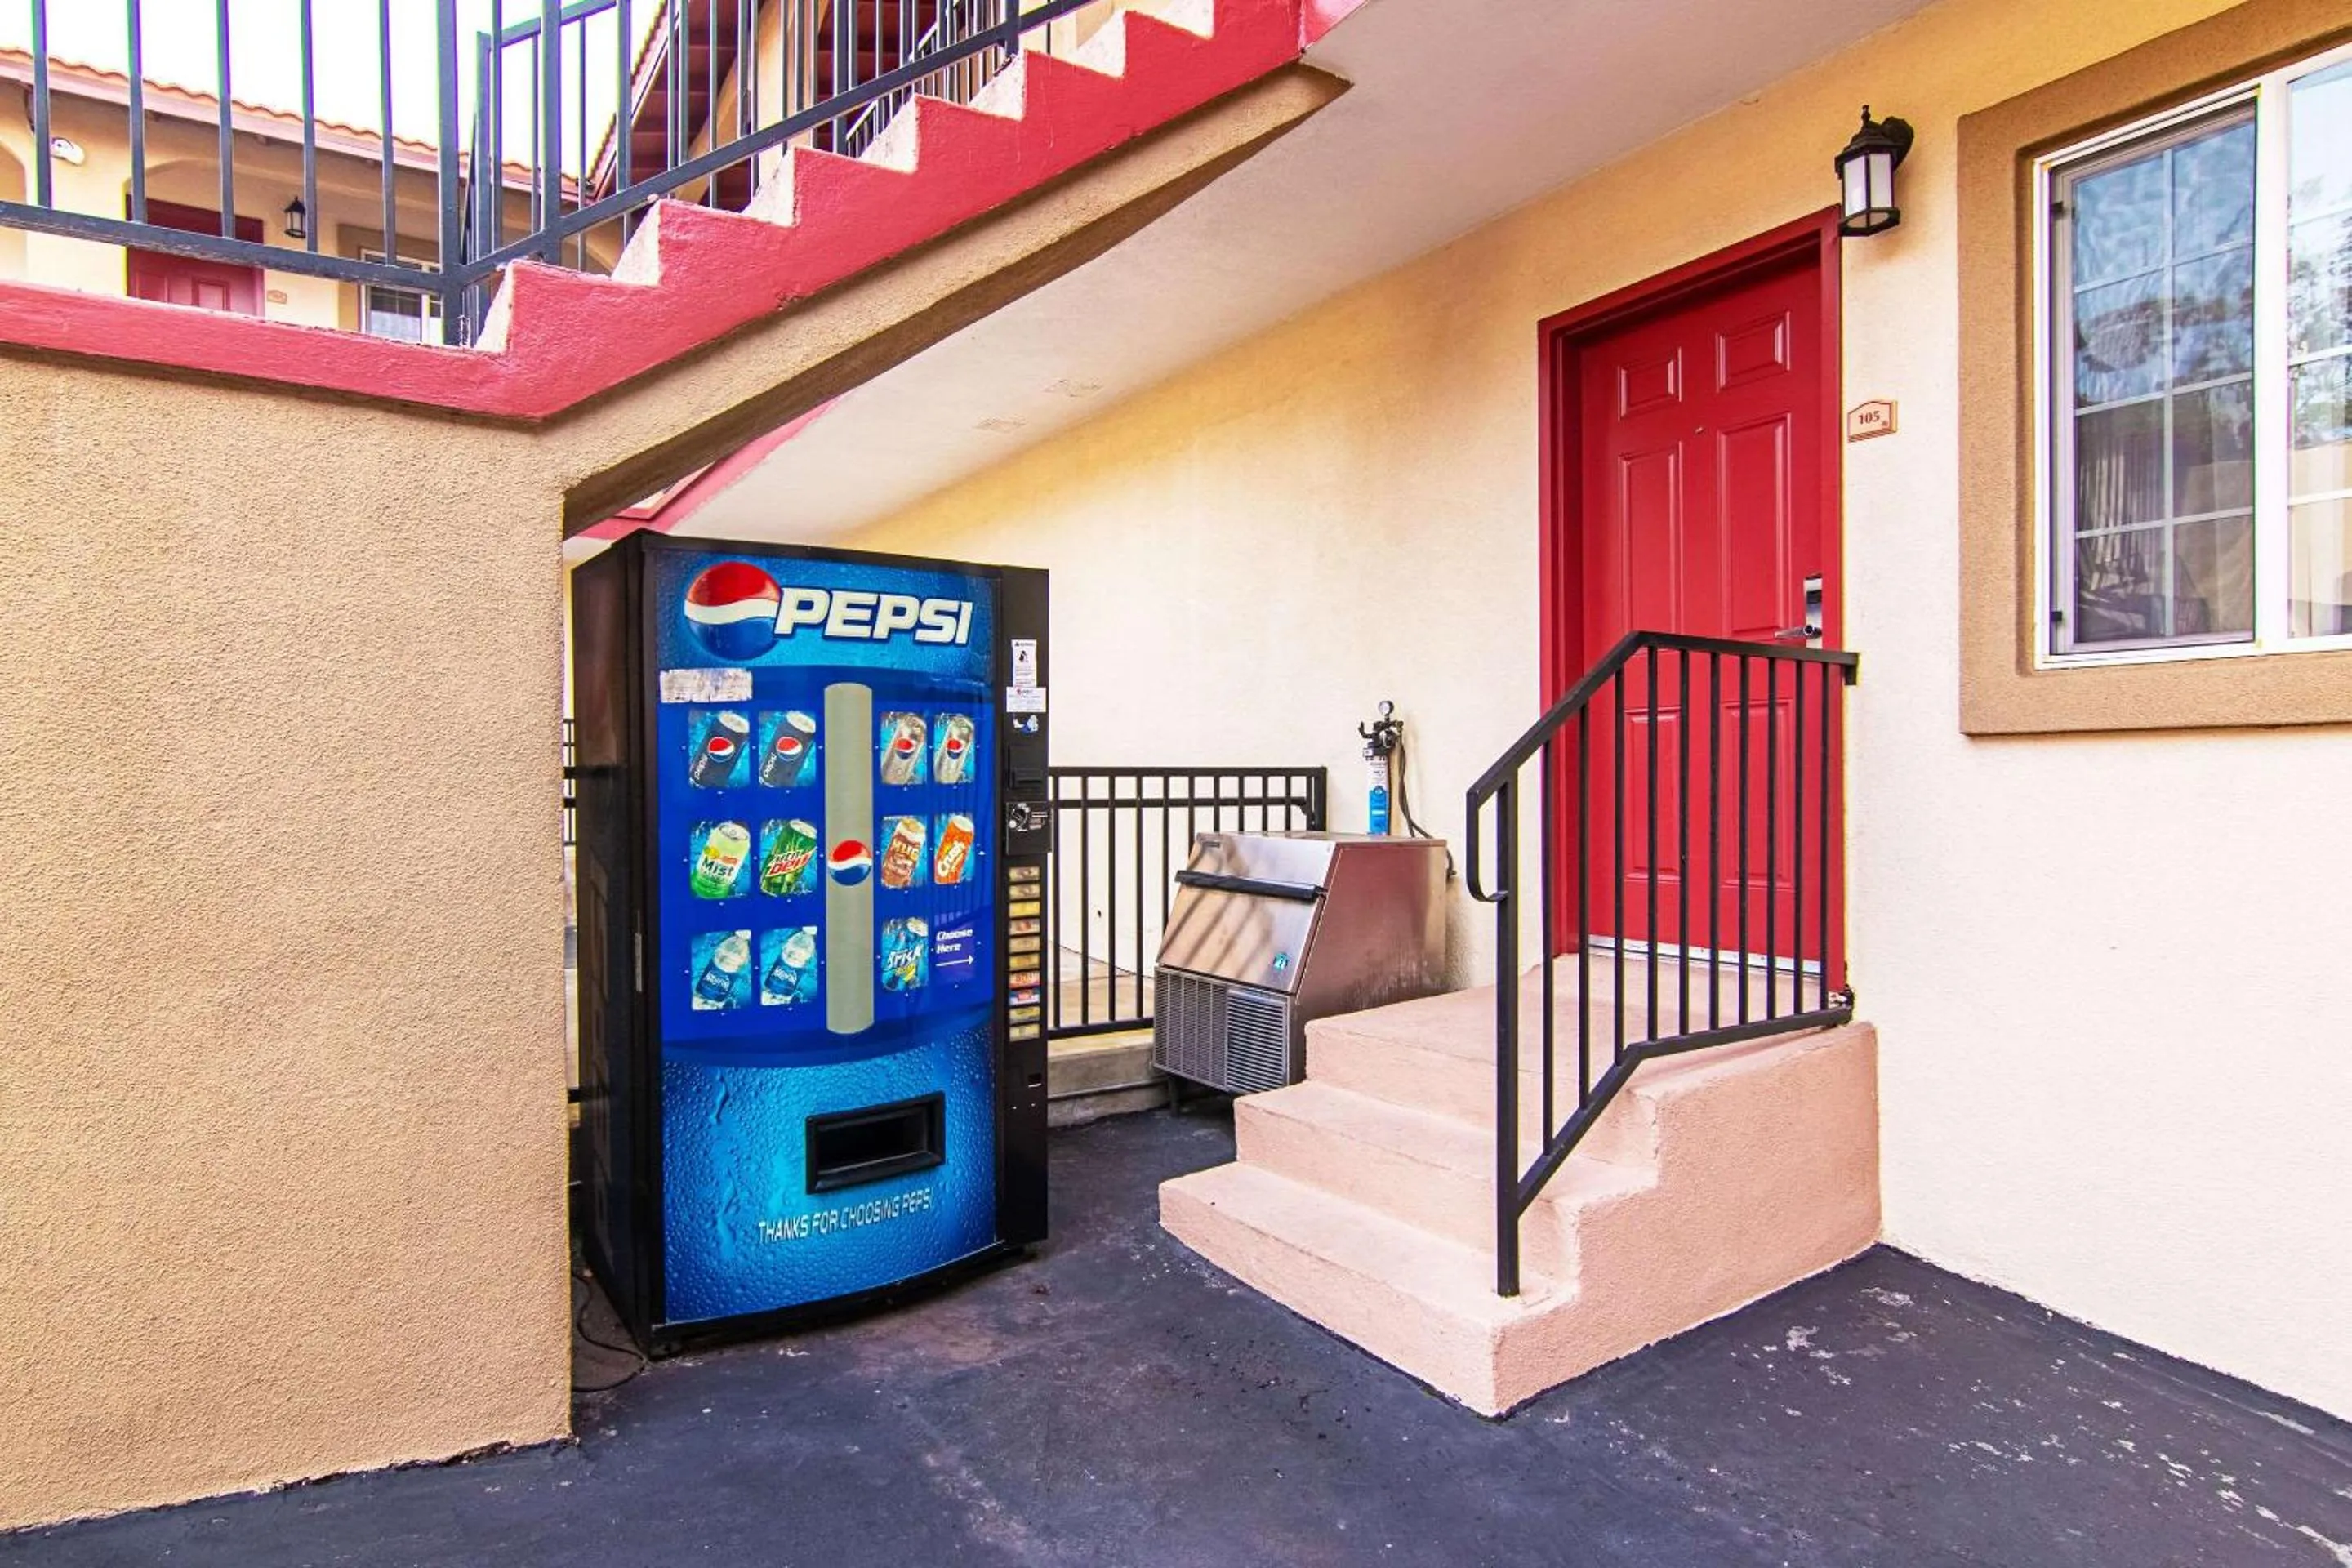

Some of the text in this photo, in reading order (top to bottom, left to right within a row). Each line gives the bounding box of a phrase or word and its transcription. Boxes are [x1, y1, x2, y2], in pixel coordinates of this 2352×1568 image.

[1858, 411, 1880, 425] 105
[774, 587, 974, 644] PEPSI
[936, 943, 961, 954] Here
[758, 1214, 809, 1245] THANKS
[812, 1211, 839, 1234] FOR
[840, 1196, 900, 1230] CHOOSING
